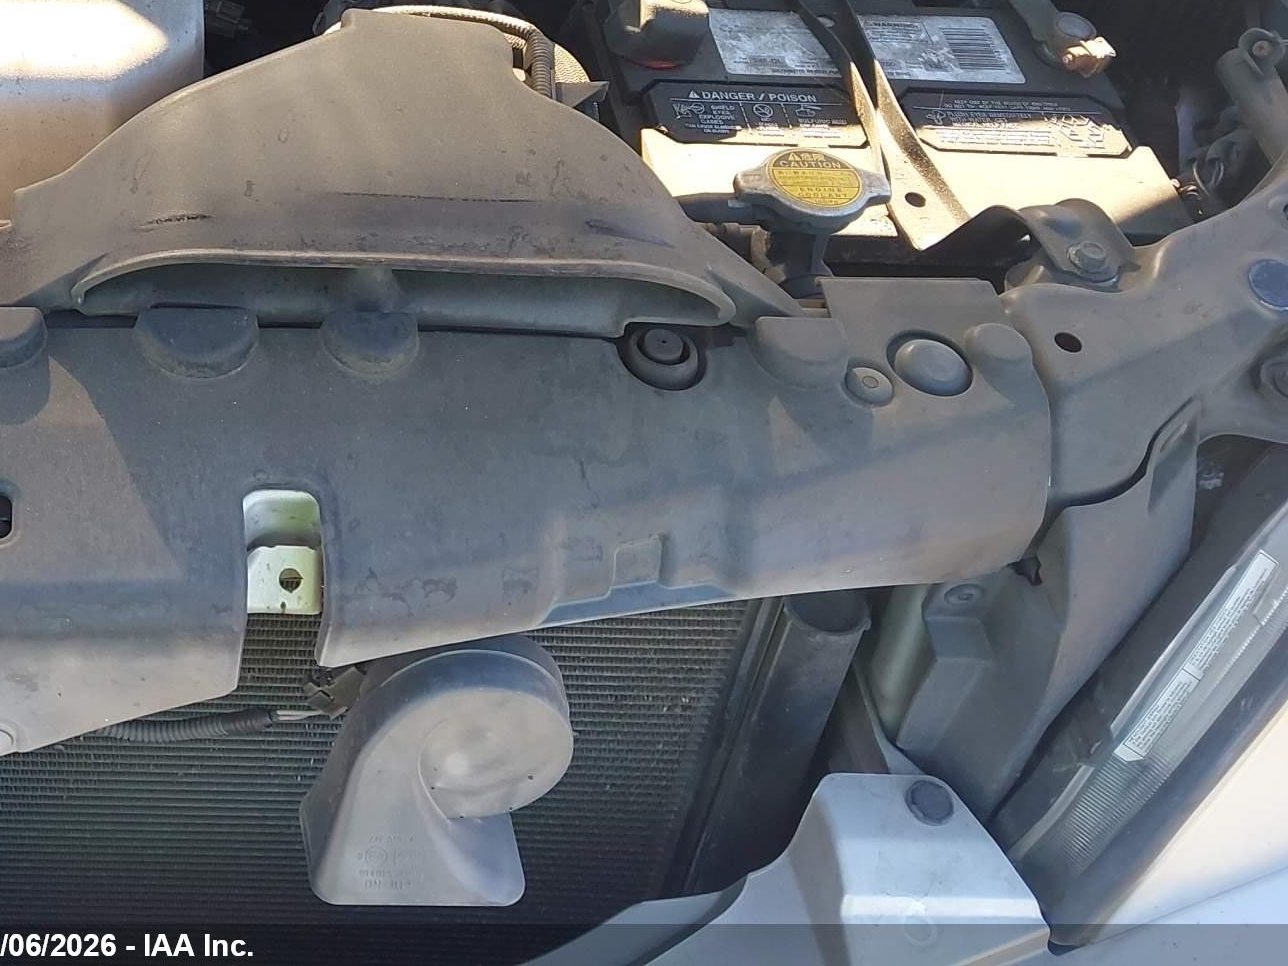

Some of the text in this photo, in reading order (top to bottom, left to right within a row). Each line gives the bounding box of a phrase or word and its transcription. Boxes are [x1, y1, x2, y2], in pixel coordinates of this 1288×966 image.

[701, 91, 756, 101] DANGER
[768, 93, 817, 102] POISON
[779, 160, 841, 170] CAUTION
